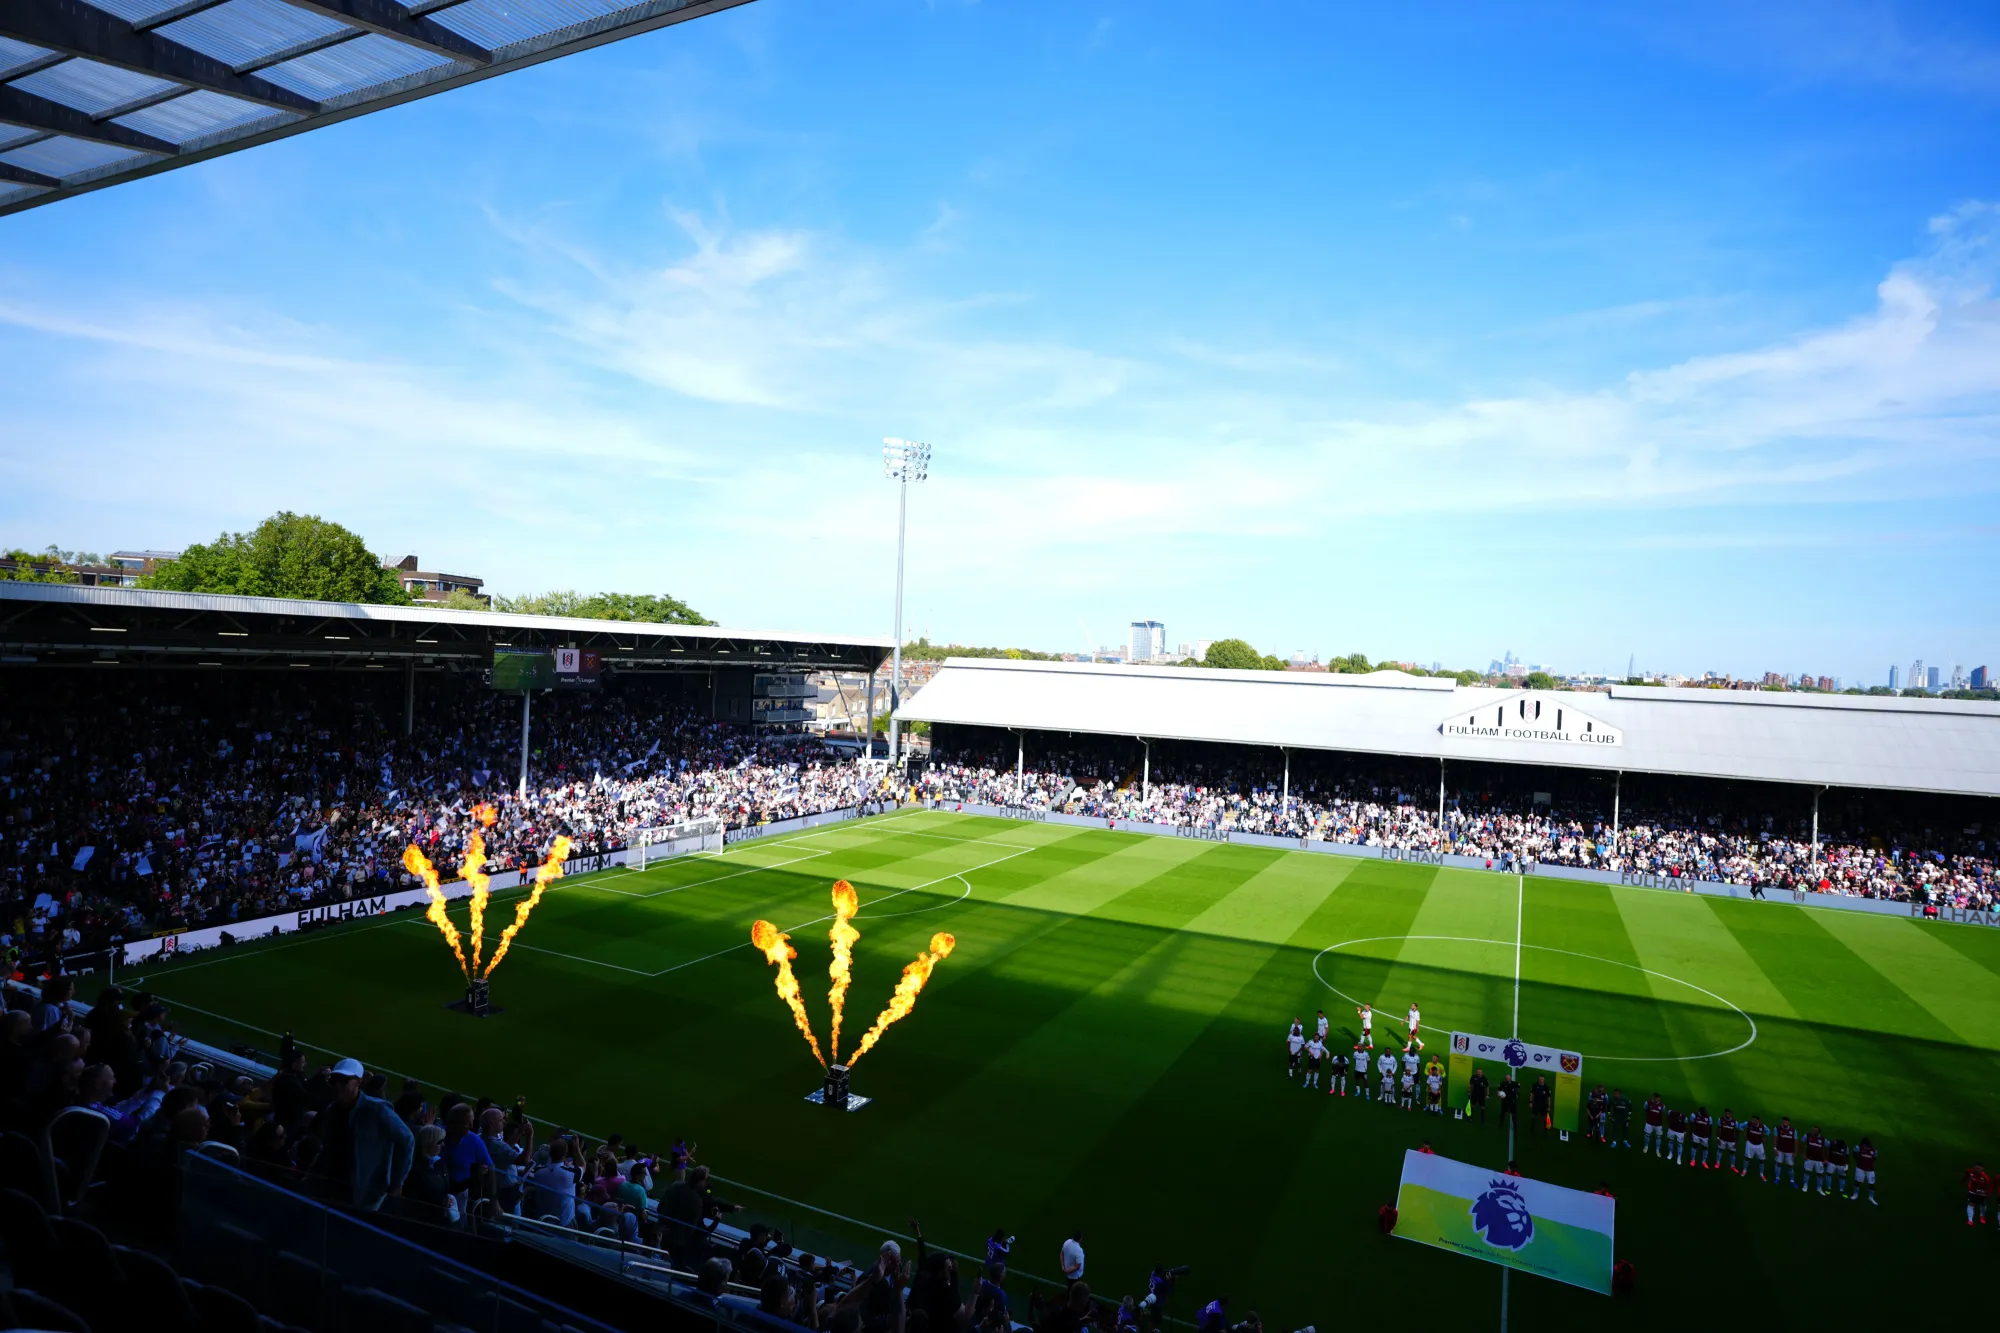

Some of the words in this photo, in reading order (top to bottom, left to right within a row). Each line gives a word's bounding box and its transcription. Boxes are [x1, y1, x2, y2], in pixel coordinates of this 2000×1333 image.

[581, 677, 596, 685] League
[1448, 724, 1499, 737] FULHAM
[1505, 728, 1572, 741] FOOTBALL
[1579, 733, 1615, 744] CLUB
[999, 807, 1046, 822] FULHAM
[1176, 826, 1230, 842] FULHAM
[561, 854, 611, 876] ULHAM
[1381, 847, 1444, 865] FULHAM
[1622, 872, 1695, 892] FULHAM
[1911, 903, 2000, 928] FLHAM
[1438, 1237, 1460, 1247] Premier
